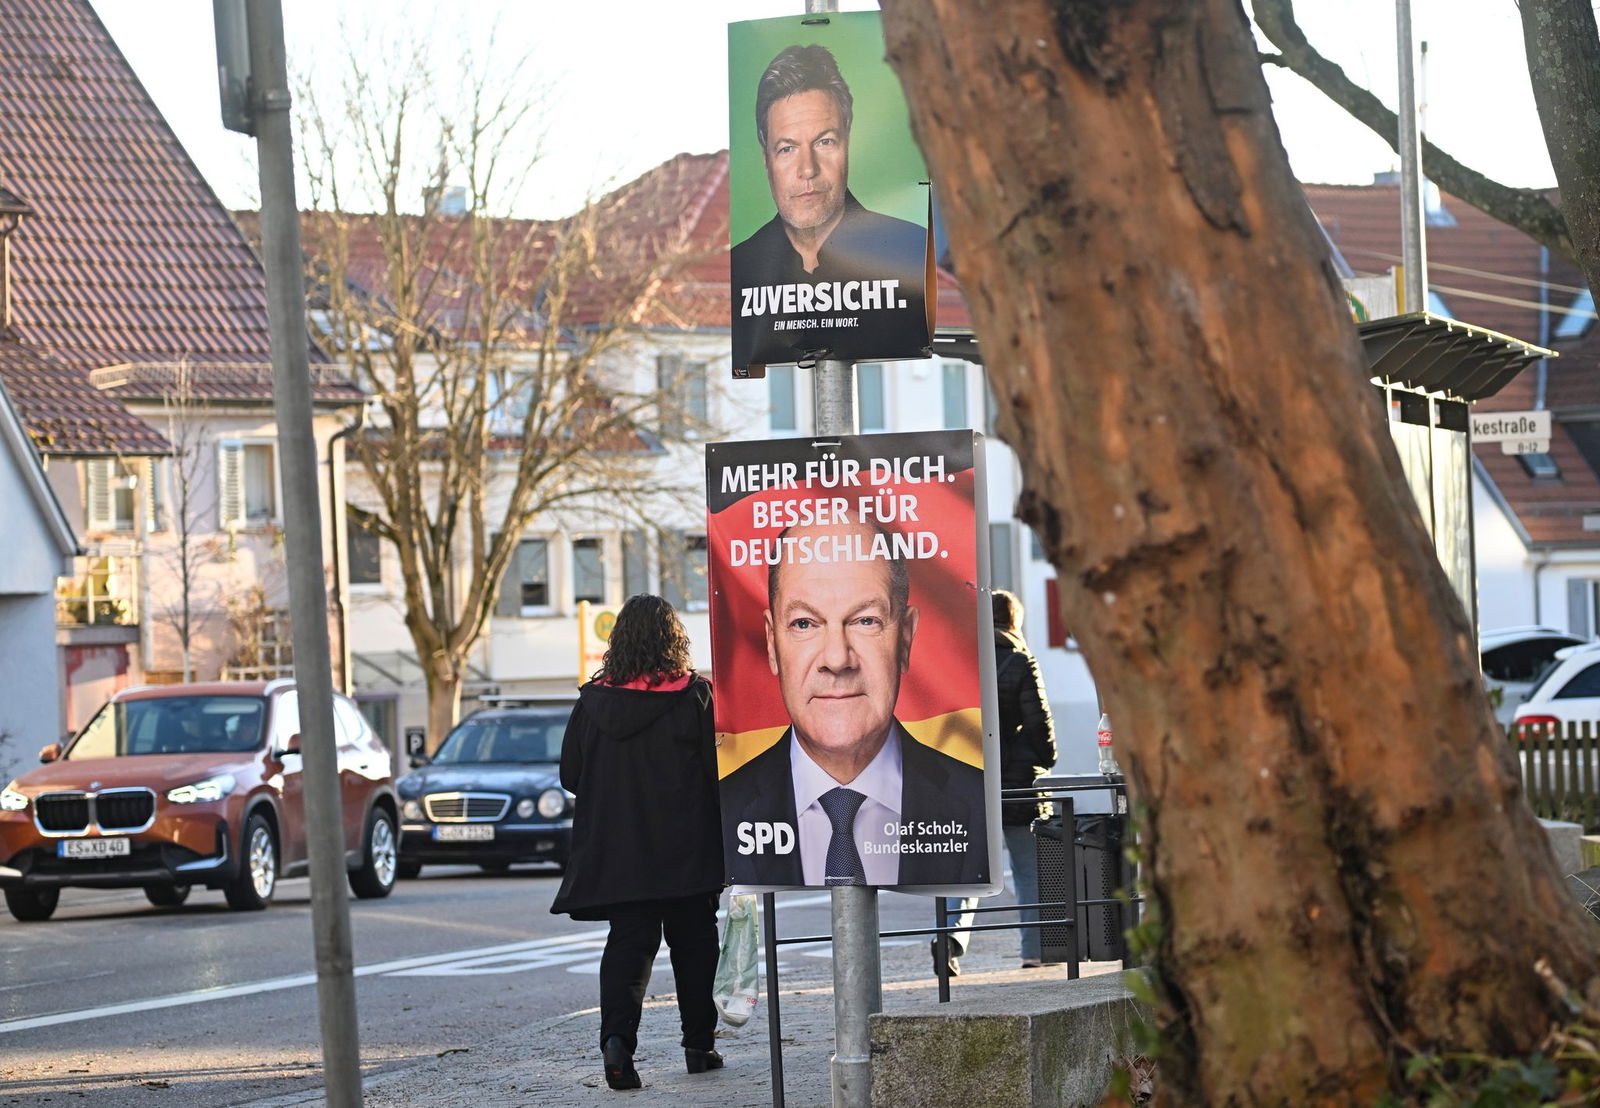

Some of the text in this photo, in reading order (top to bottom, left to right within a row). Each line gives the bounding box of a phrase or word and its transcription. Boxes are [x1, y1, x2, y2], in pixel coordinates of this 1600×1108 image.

[741, 280, 907, 317] ZUVERSICHT.
[774, 317, 859, 331] EIN MENSCH. EIN WORT.
[1473, 417, 1536, 435] kestraße
[721, 453, 955, 493] MEHR FÜR DICH.
[752, 488, 919, 529] BESSER FÜR
[730, 531, 949, 567] DEUTSCHLAND.
[736, 821, 795, 855] SPD
[884, 820, 968, 837] Olaf Scholz,
[863, 839, 968, 855] Bundeskanzler
